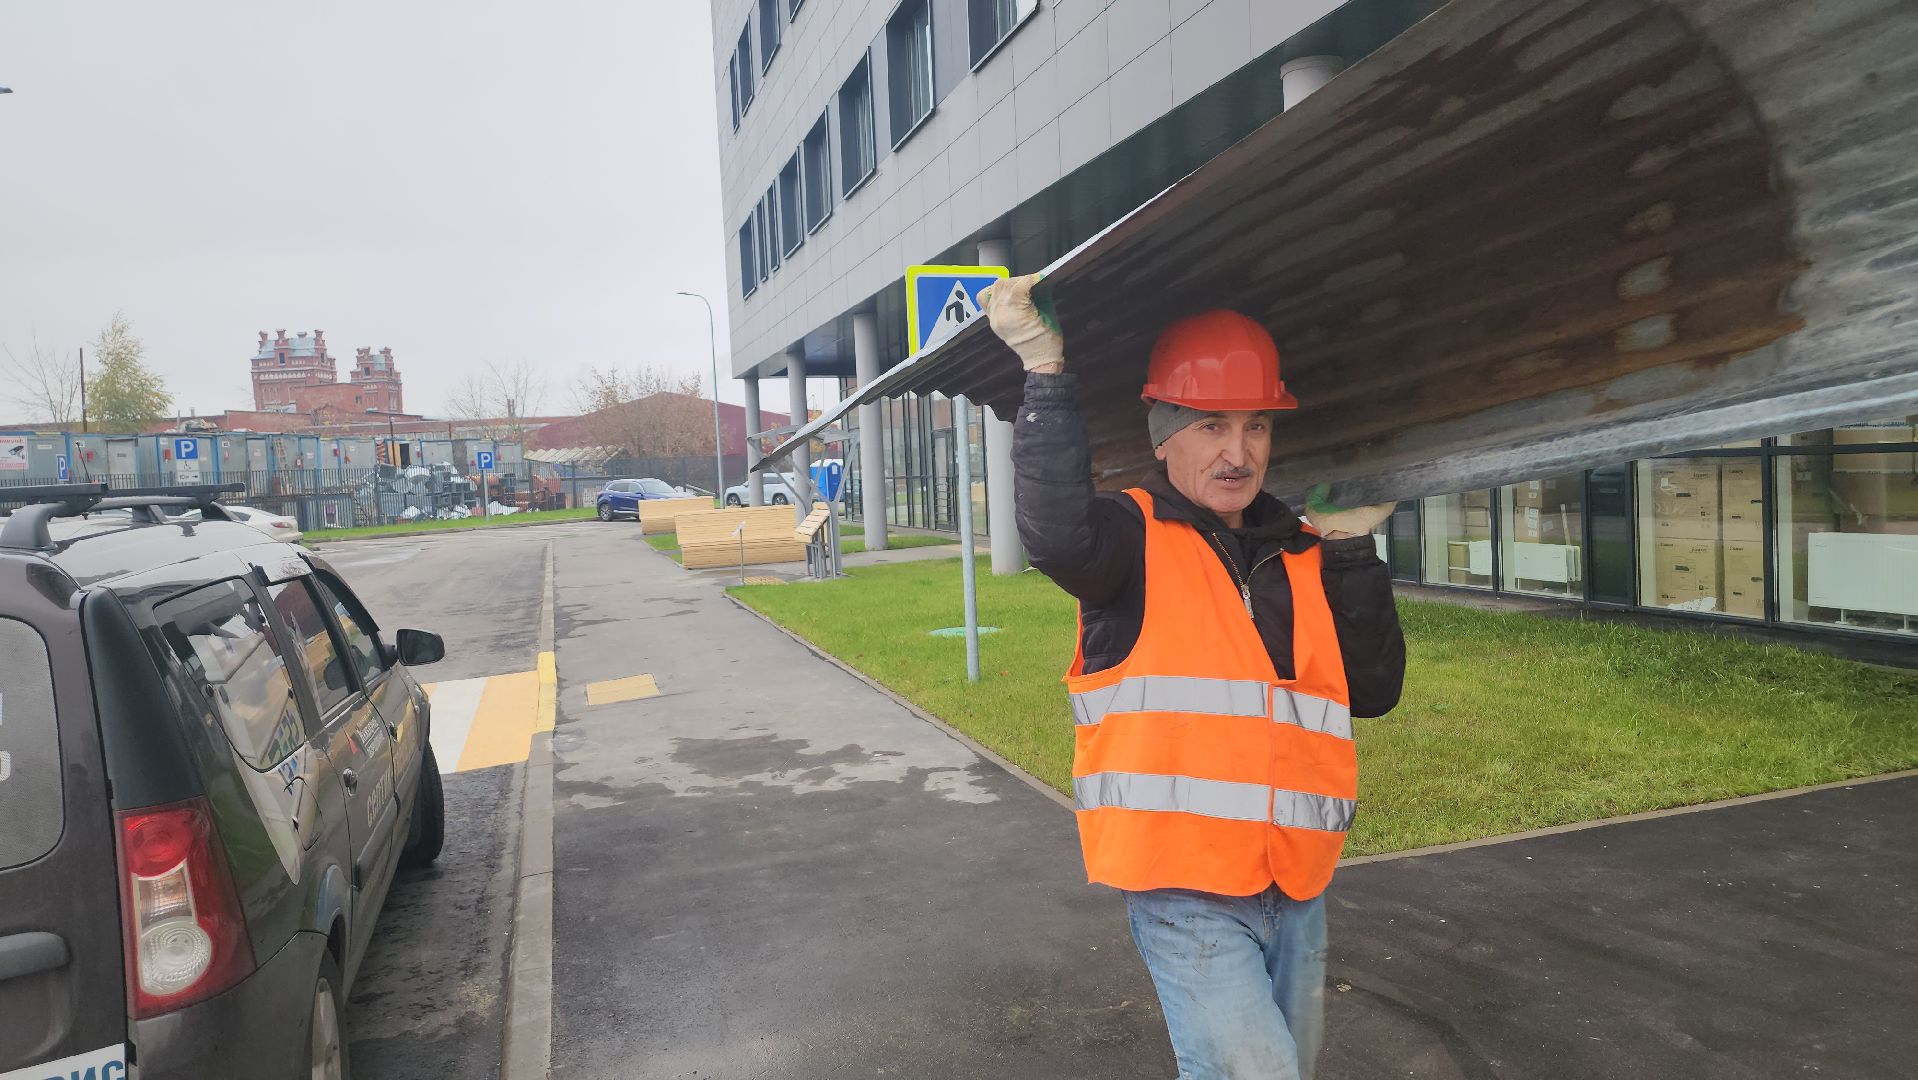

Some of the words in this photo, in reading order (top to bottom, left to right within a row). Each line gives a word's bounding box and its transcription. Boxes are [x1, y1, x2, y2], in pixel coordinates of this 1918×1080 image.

[181, 440, 194, 458] P
[60, 457, 66, 478] P
[481, 453, 491, 468] P
